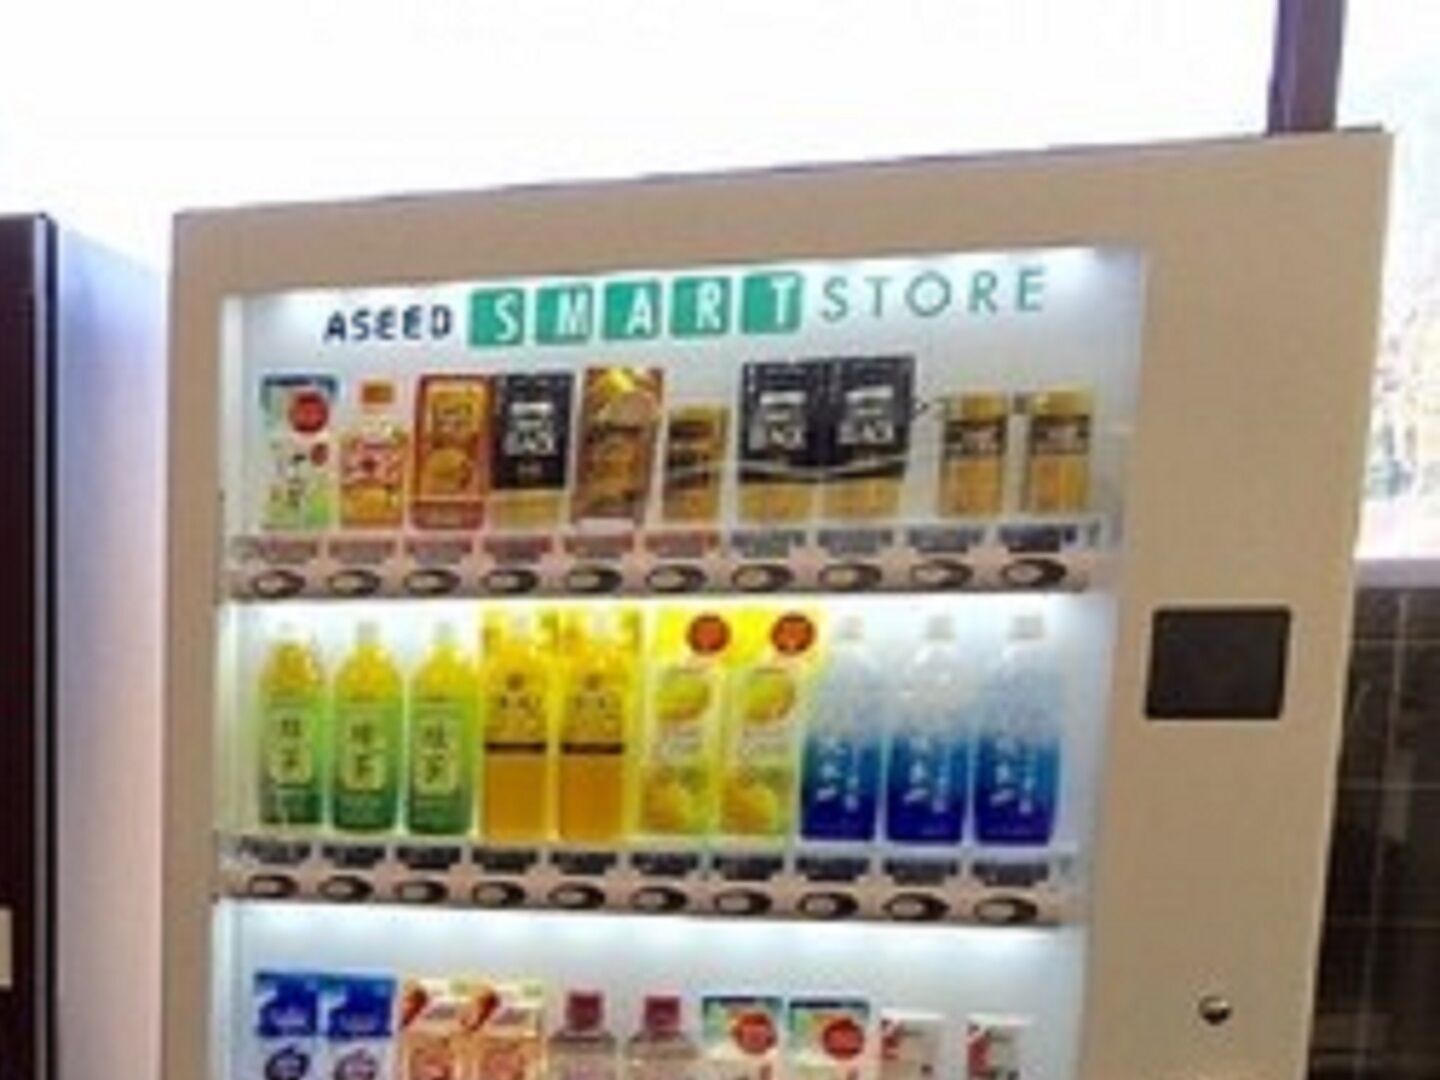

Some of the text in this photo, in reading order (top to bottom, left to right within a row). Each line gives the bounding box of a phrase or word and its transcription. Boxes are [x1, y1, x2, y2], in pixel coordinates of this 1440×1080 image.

[323, 266, 1046, 343] ASEED SMART STORE
